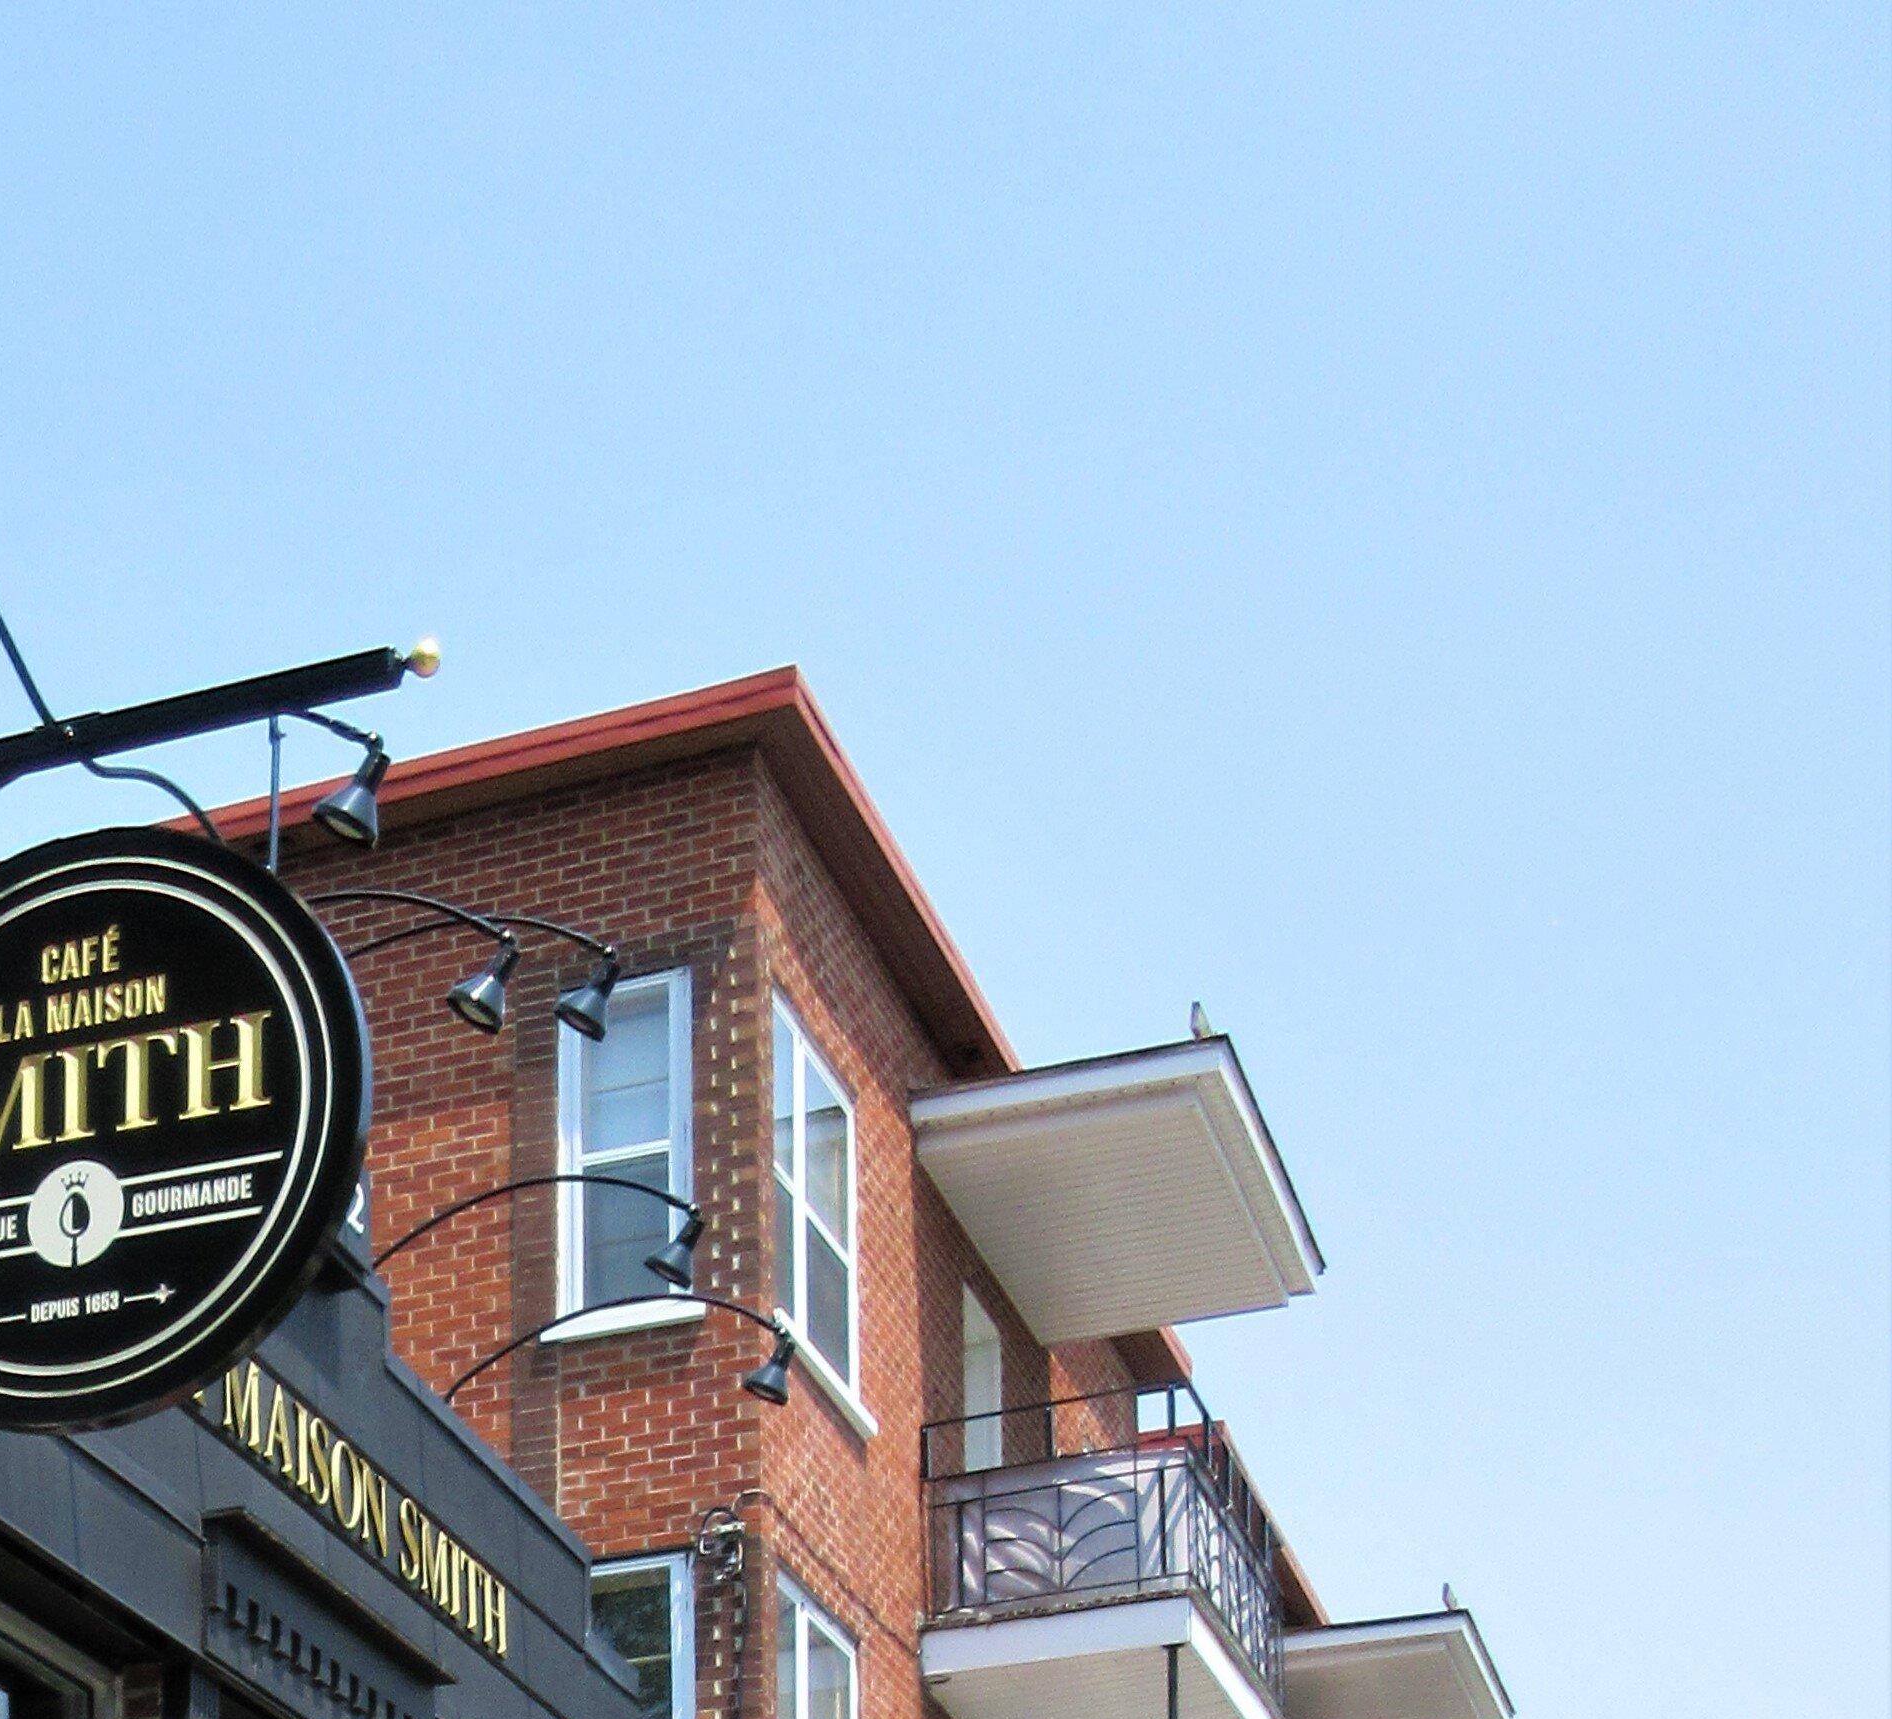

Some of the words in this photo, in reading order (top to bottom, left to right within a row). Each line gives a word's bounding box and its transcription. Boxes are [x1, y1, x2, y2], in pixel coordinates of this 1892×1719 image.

[40, 923, 121, 985] CAFÉ
[46, 973, 168, 1036] MAISON
[131, 1173, 254, 1220] GOURMANDE
[30, 1296, 80, 1324] DEPUIS
[223, 1361, 388, 1558] MAISON
[399, 1497, 508, 1655] SMITH
